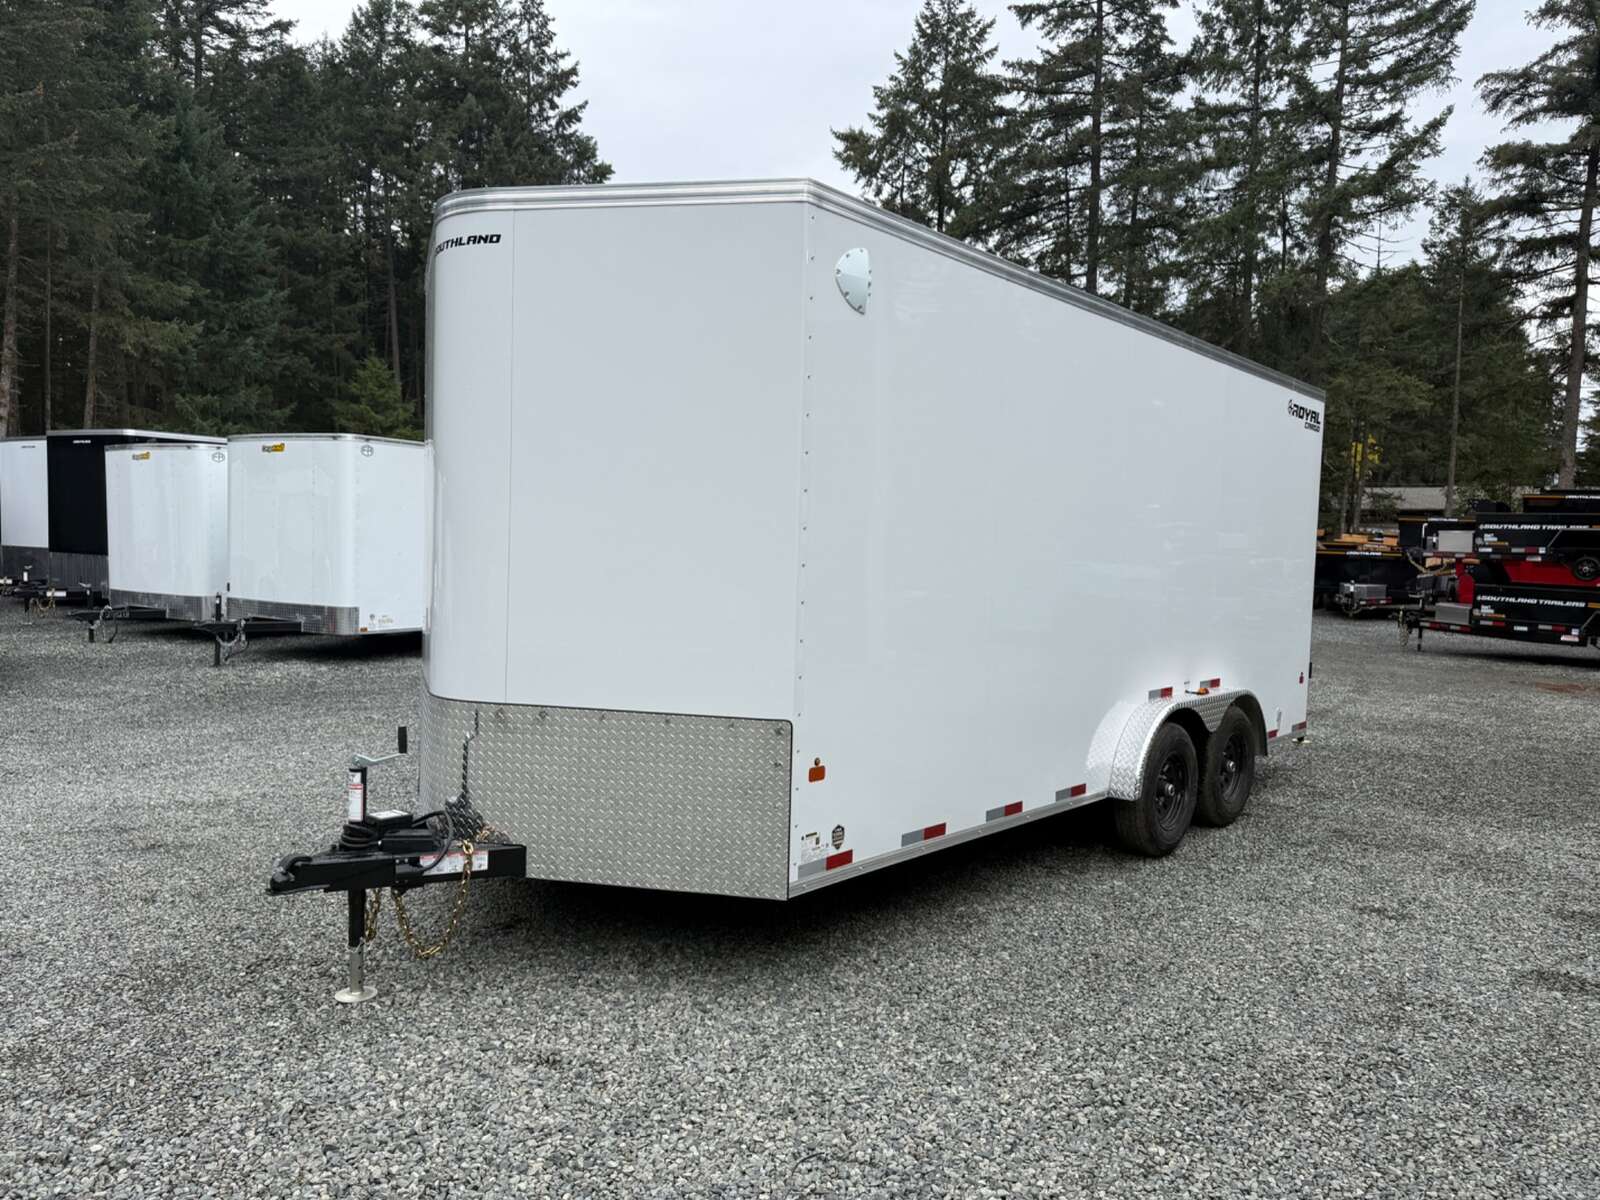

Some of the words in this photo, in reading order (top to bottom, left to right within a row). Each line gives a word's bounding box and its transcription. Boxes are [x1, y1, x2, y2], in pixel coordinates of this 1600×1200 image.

[435, 234, 501, 256] OUTHLAND
[1292, 404, 1320, 424] ROYAL
[1480, 595, 1538, 604] SOUTHLAND
[1539, 599, 1586, 607] TRAILERS
